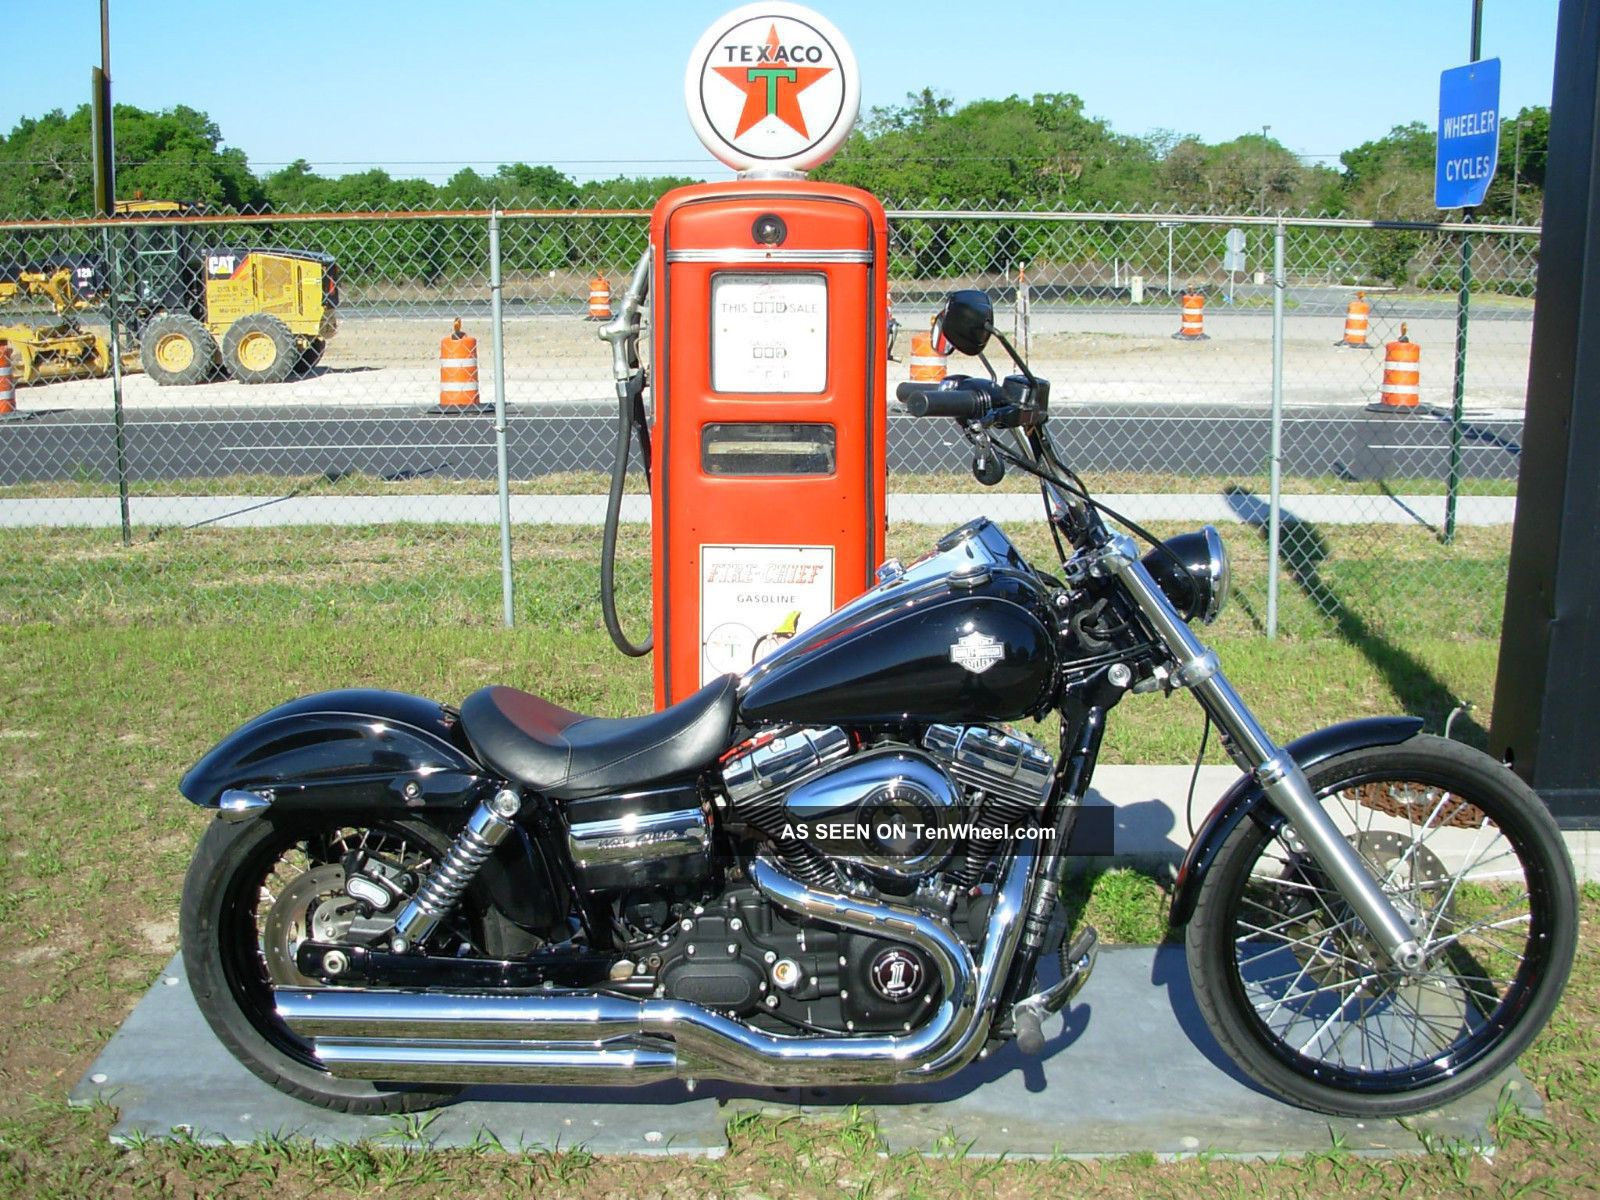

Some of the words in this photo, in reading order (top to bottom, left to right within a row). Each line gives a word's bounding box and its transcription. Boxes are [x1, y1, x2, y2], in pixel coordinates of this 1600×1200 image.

[724, 45, 823, 63] TEXACO
[746, 67, 797, 116] T
[1443, 109, 1495, 139] WHEELER
[1446, 155, 1490, 182] CYCLES
[208, 256, 235, 274] CAT
[721, 303, 748, 313] THIS
[789, 303, 818, 313] SALE
[737, 595, 796, 604] GASOLINE
